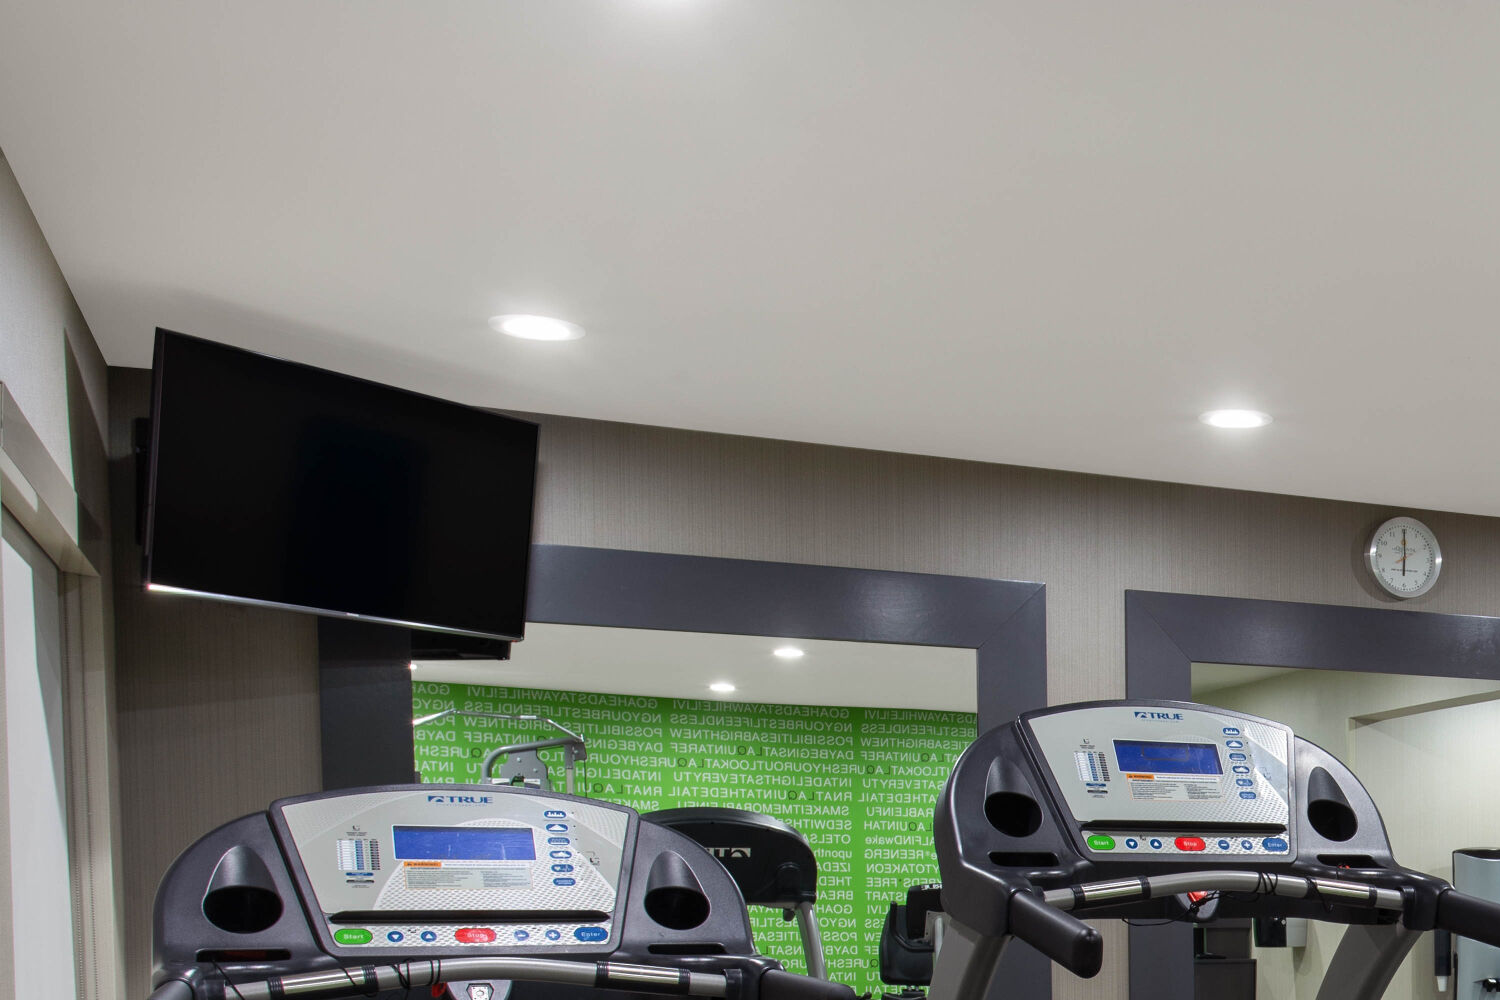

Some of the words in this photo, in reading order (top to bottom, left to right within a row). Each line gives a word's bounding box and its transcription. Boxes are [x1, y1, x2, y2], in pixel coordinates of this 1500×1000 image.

[1147, 712, 1184, 721] TRUE
[446, 795, 494, 804] TRUE
[343, 932, 364, 940] Start
